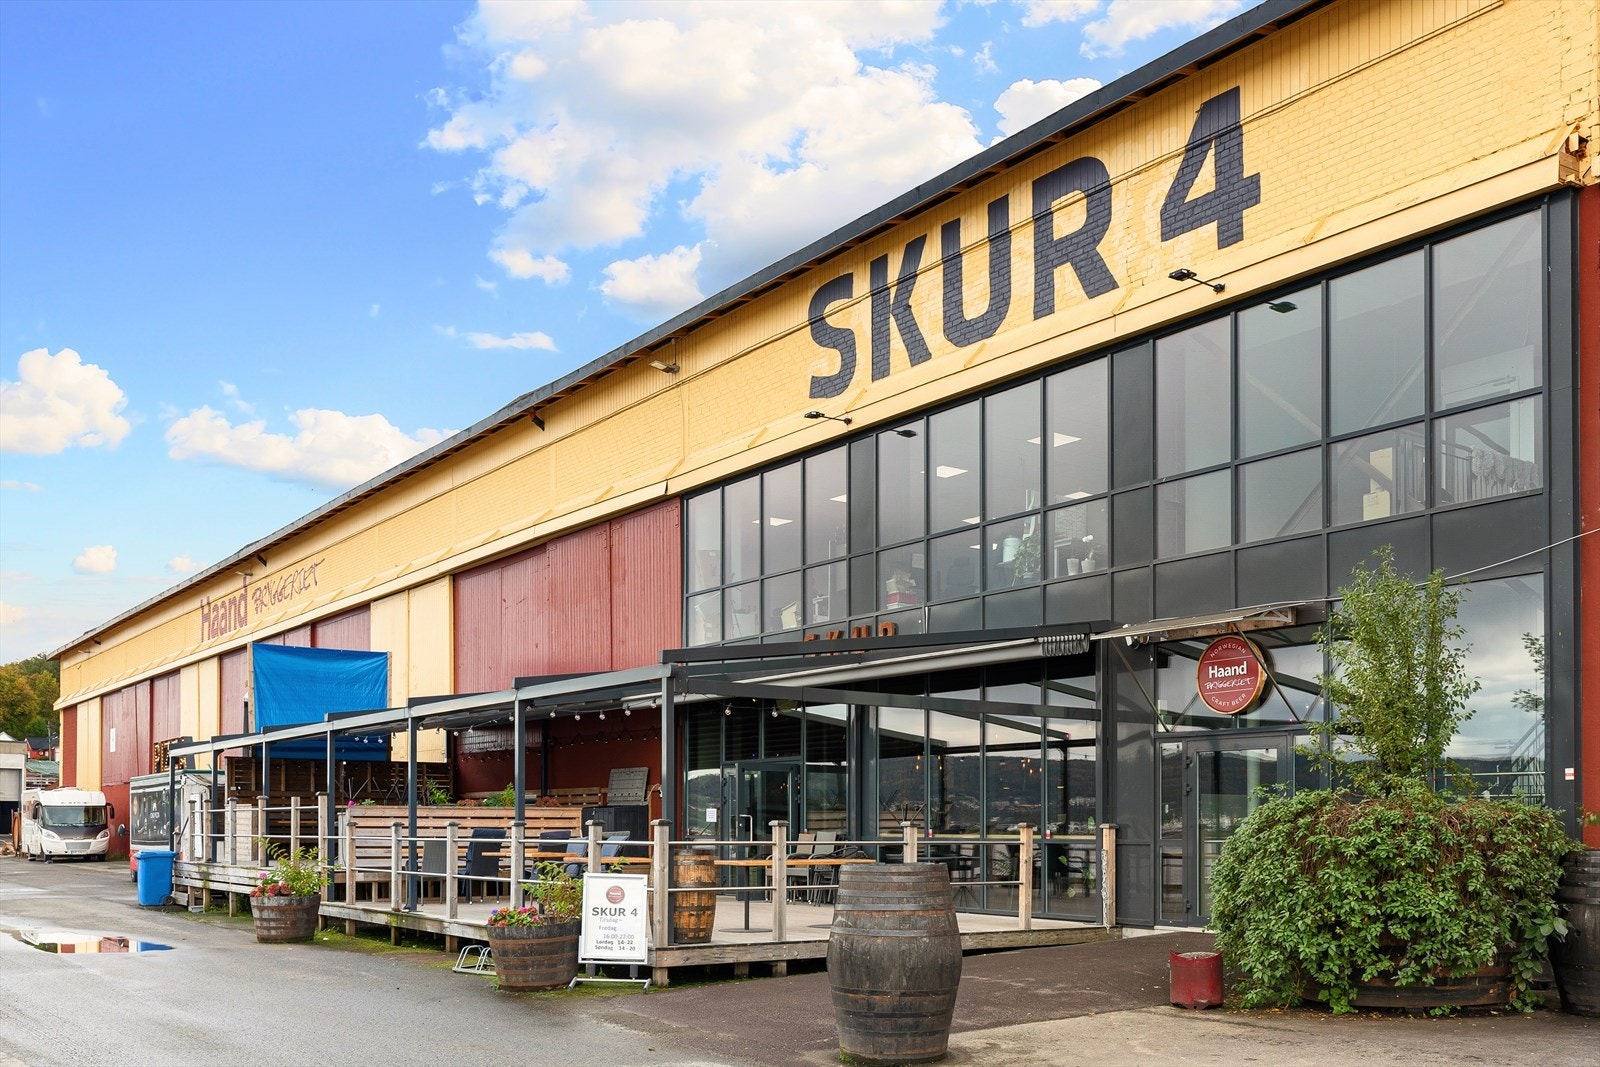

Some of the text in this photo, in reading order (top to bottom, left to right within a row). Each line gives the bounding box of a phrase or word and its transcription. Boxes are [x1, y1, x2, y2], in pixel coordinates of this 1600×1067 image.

[808, 86, 1261, 399] SKUR 4
[200, 576, 248, 642] Haand
[1210, 642, 1247, 658] NORWEGIAN
[1208, 661, 1247, 679] Haand
[1211, 693, 1246, 707] CRAFT BEER
[591, 907, 638, 917] SKUR 4
